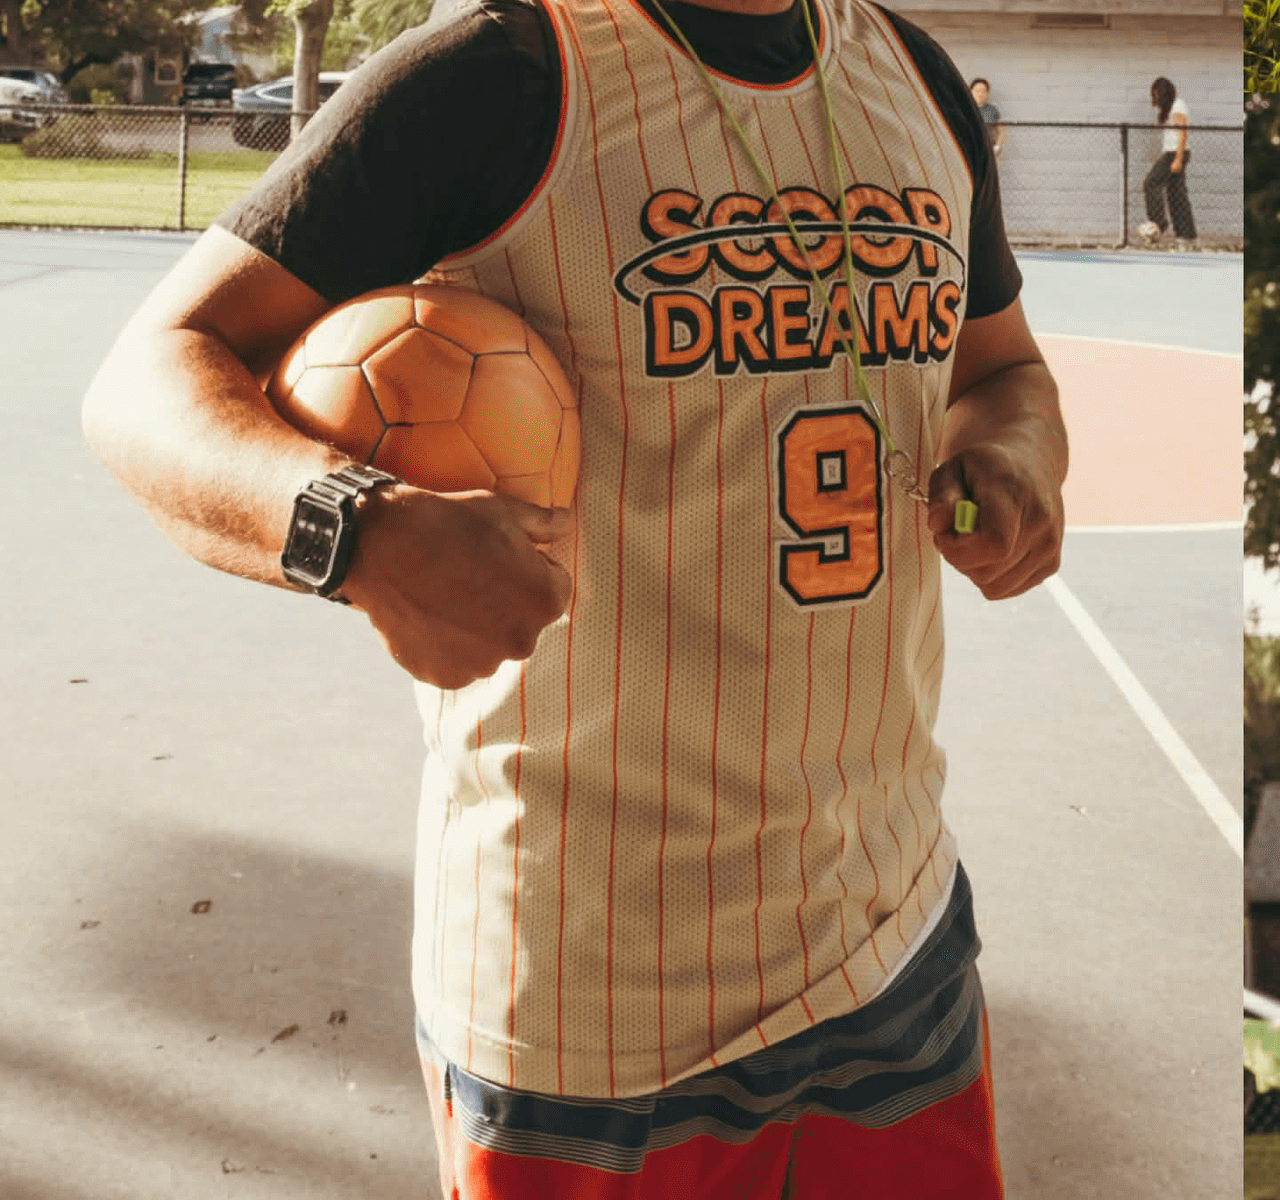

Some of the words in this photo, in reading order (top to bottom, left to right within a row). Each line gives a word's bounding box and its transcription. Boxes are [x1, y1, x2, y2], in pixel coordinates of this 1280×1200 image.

[640, 183, 952, 285] SCOOP
[642, 280, 962, 377] DREAMS
[777, 406, 884, 606] 9
